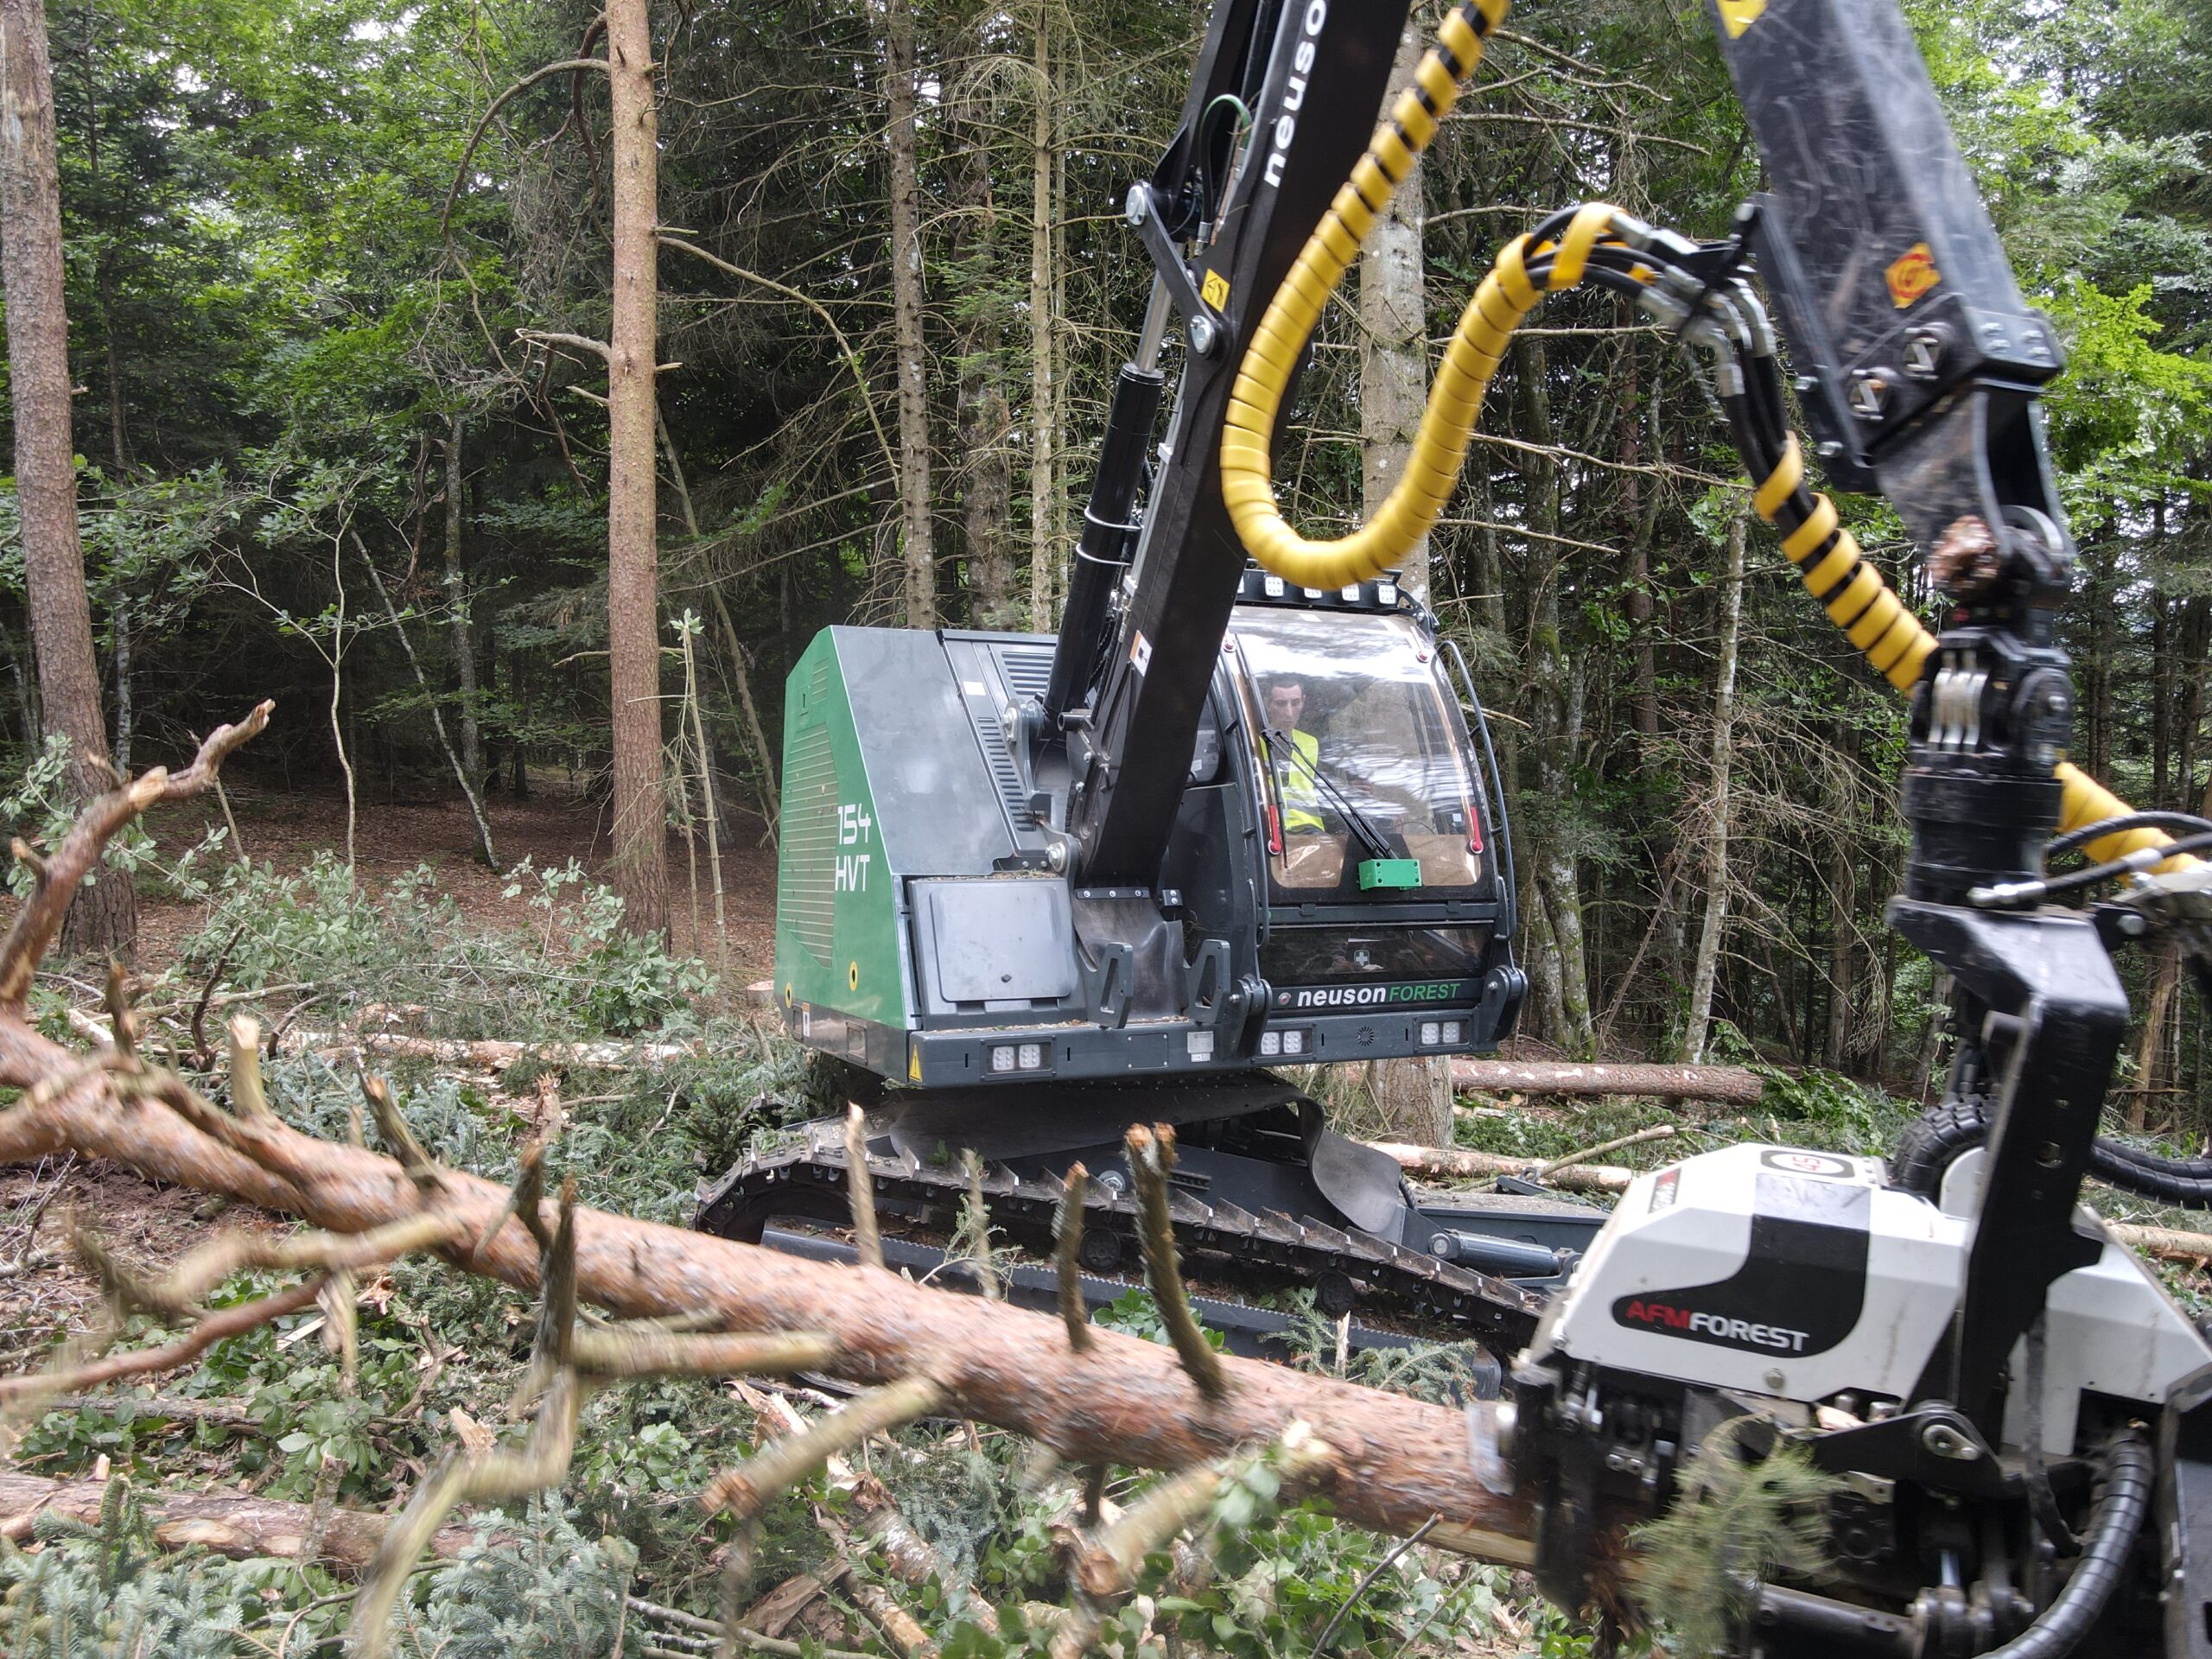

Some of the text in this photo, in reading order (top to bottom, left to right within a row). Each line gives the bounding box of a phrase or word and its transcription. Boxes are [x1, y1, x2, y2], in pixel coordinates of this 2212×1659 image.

[838, 804, 872, 846] 154
[835, 855, 871, 893] HVT
[1297, 982, 1461, 1007] neuson FOREST
